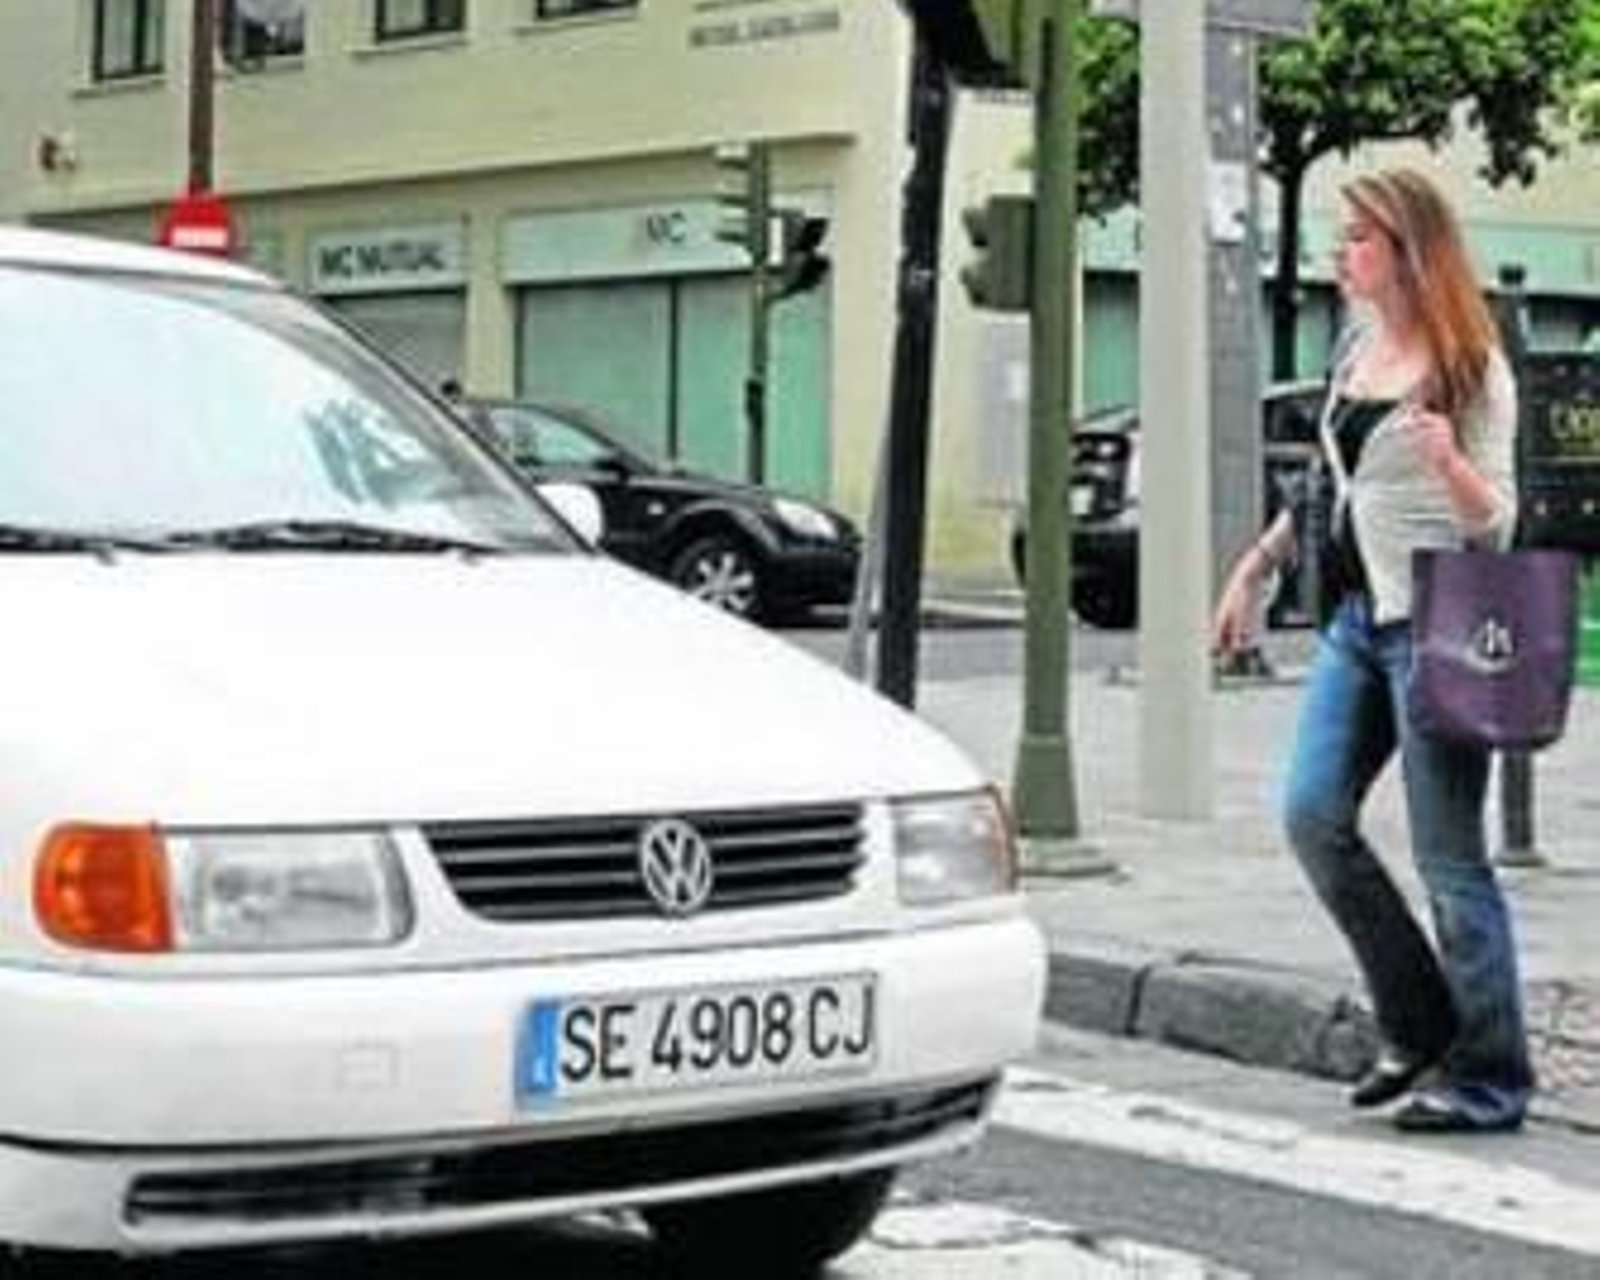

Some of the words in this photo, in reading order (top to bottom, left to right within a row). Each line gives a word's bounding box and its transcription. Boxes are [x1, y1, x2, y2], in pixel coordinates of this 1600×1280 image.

[561, 1005, 635, 1083] SE
[651, 992, 794, 1072] 4908
[807, 986, 874, 1059] CJ
